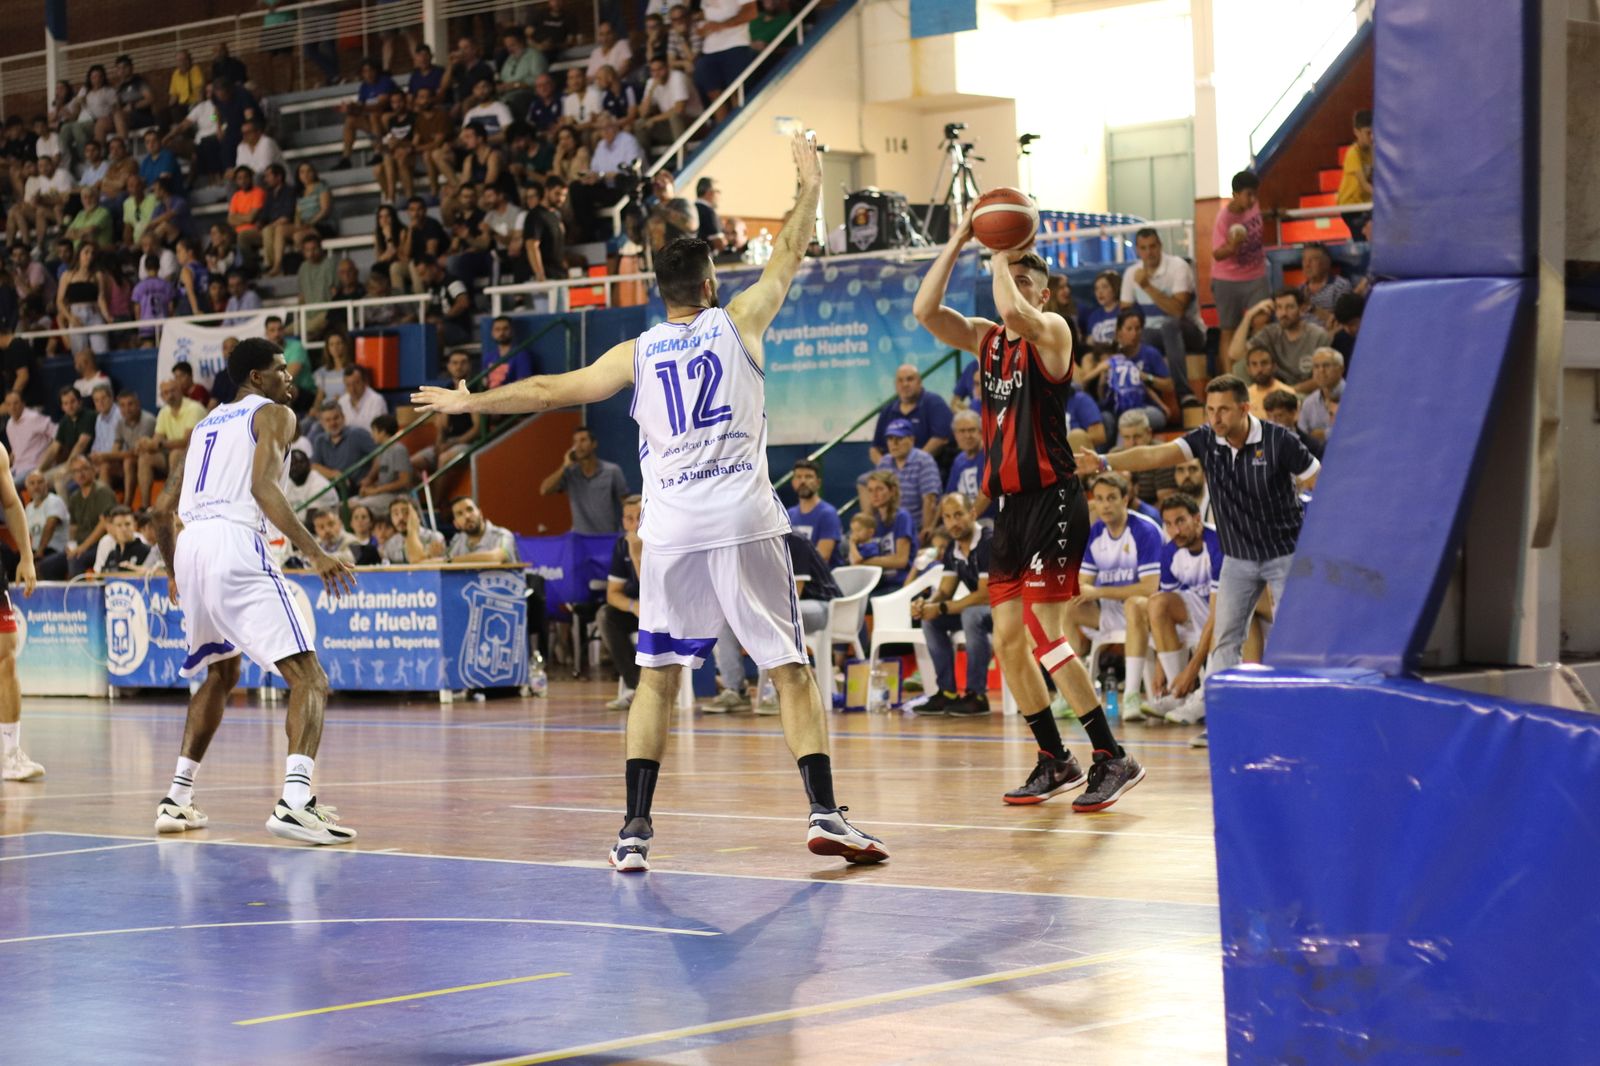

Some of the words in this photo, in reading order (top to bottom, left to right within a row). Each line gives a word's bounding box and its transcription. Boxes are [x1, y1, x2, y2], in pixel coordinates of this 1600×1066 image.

[766, 321, 869, 345] Ayuntamiento
[793, 341, 814, 357] de
[816, 338, 868, 355] Huelva
[654, 350, 733, 437] 12
[195, 430, 218, 494] 1
[660, 478, 674, 489] La
[1030, 551, 1044, 575] 4
[316, 588, 437, 614] Ayuntamiento
[42, 622, 56, 635] de
[58, 622, 88, 635] Huelva
[349, 611, 371, 631] de
[375, 610, 437, 631] Huelva
[375, 635, 390, 649] de
[392, 635, 440, 651] Deportes
